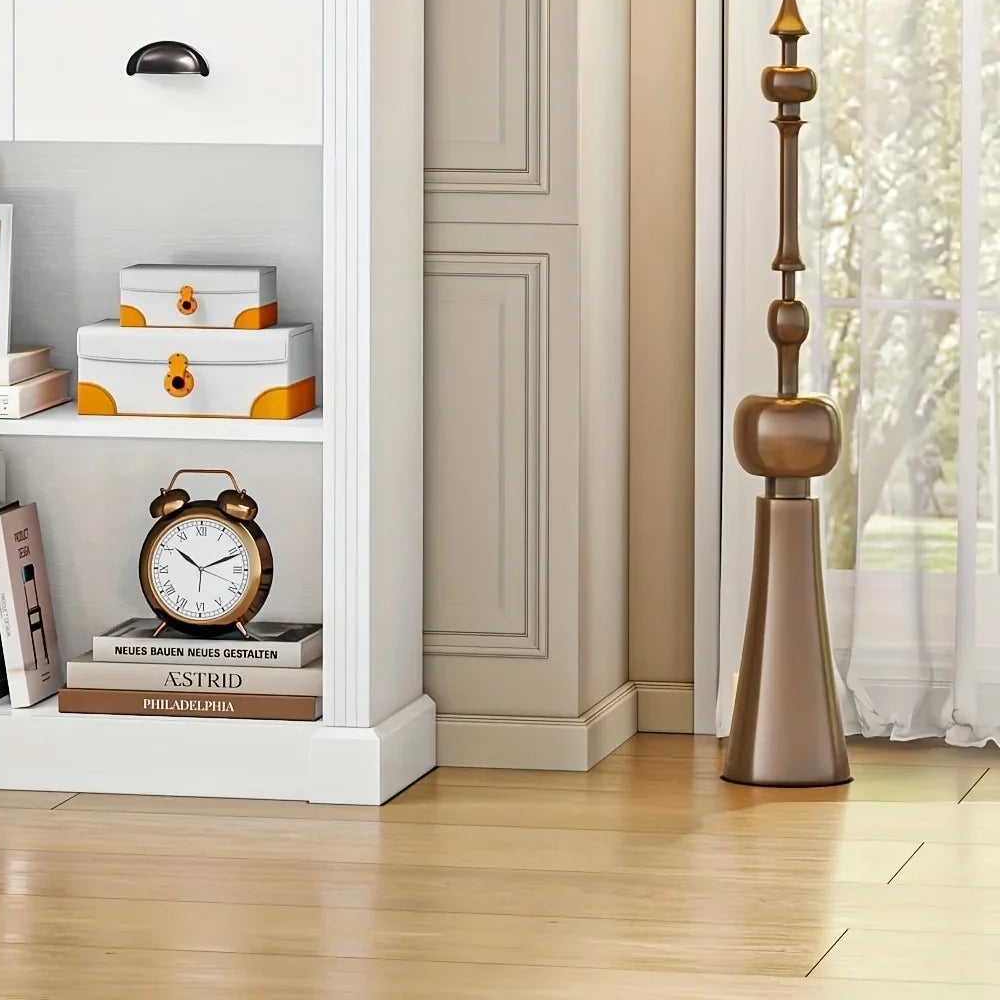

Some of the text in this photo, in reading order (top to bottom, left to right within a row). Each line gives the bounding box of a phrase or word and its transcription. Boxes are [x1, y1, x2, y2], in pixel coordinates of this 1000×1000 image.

[115, 646, 278, 659] NEUES BAUEN NEUES GESTALTEN
[164, 671, 243, 689] ÆSTRID
[143, 699, 234, 712] PHILADELPHIA
